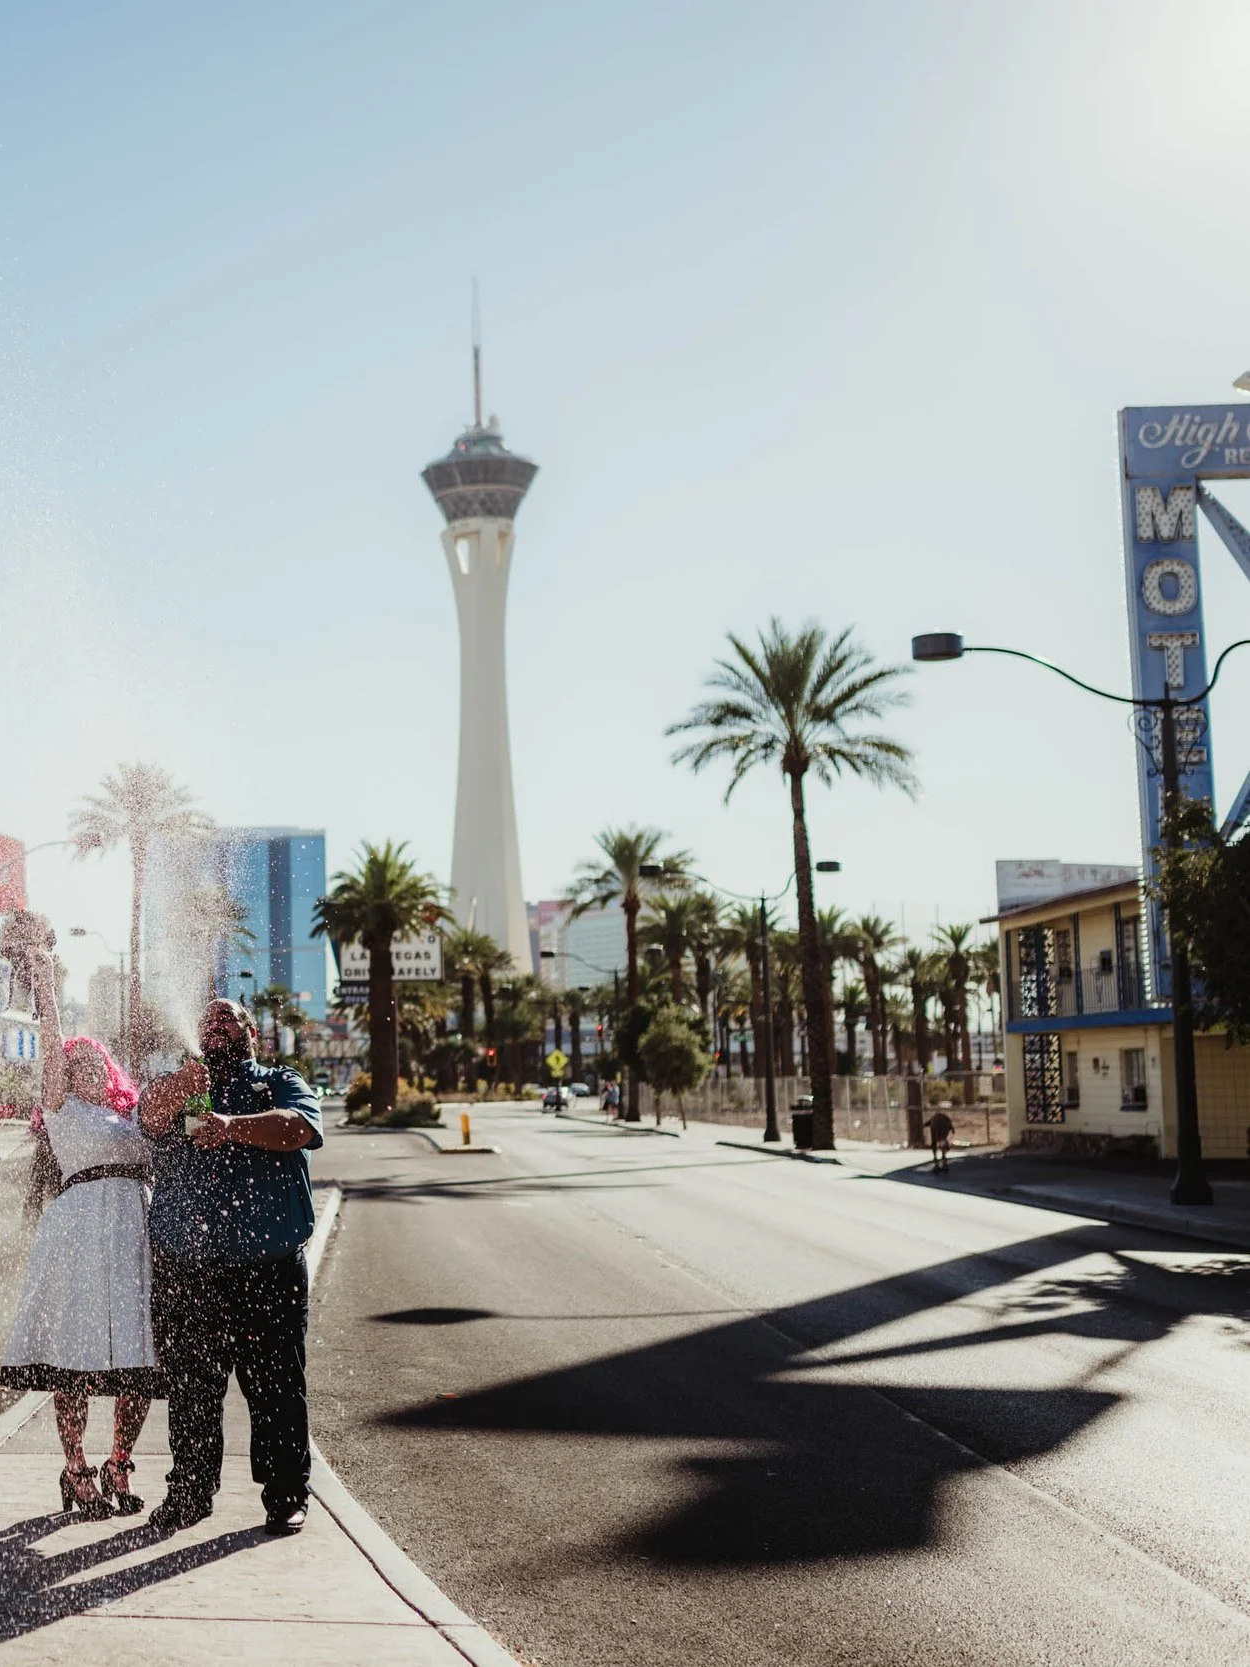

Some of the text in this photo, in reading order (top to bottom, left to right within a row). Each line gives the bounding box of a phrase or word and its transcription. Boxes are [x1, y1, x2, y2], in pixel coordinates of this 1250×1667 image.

[1138, 411, 1240, 469] High
[394, 950, 432, 961] EGAS
[396, 967, 437, 977] AFELY
